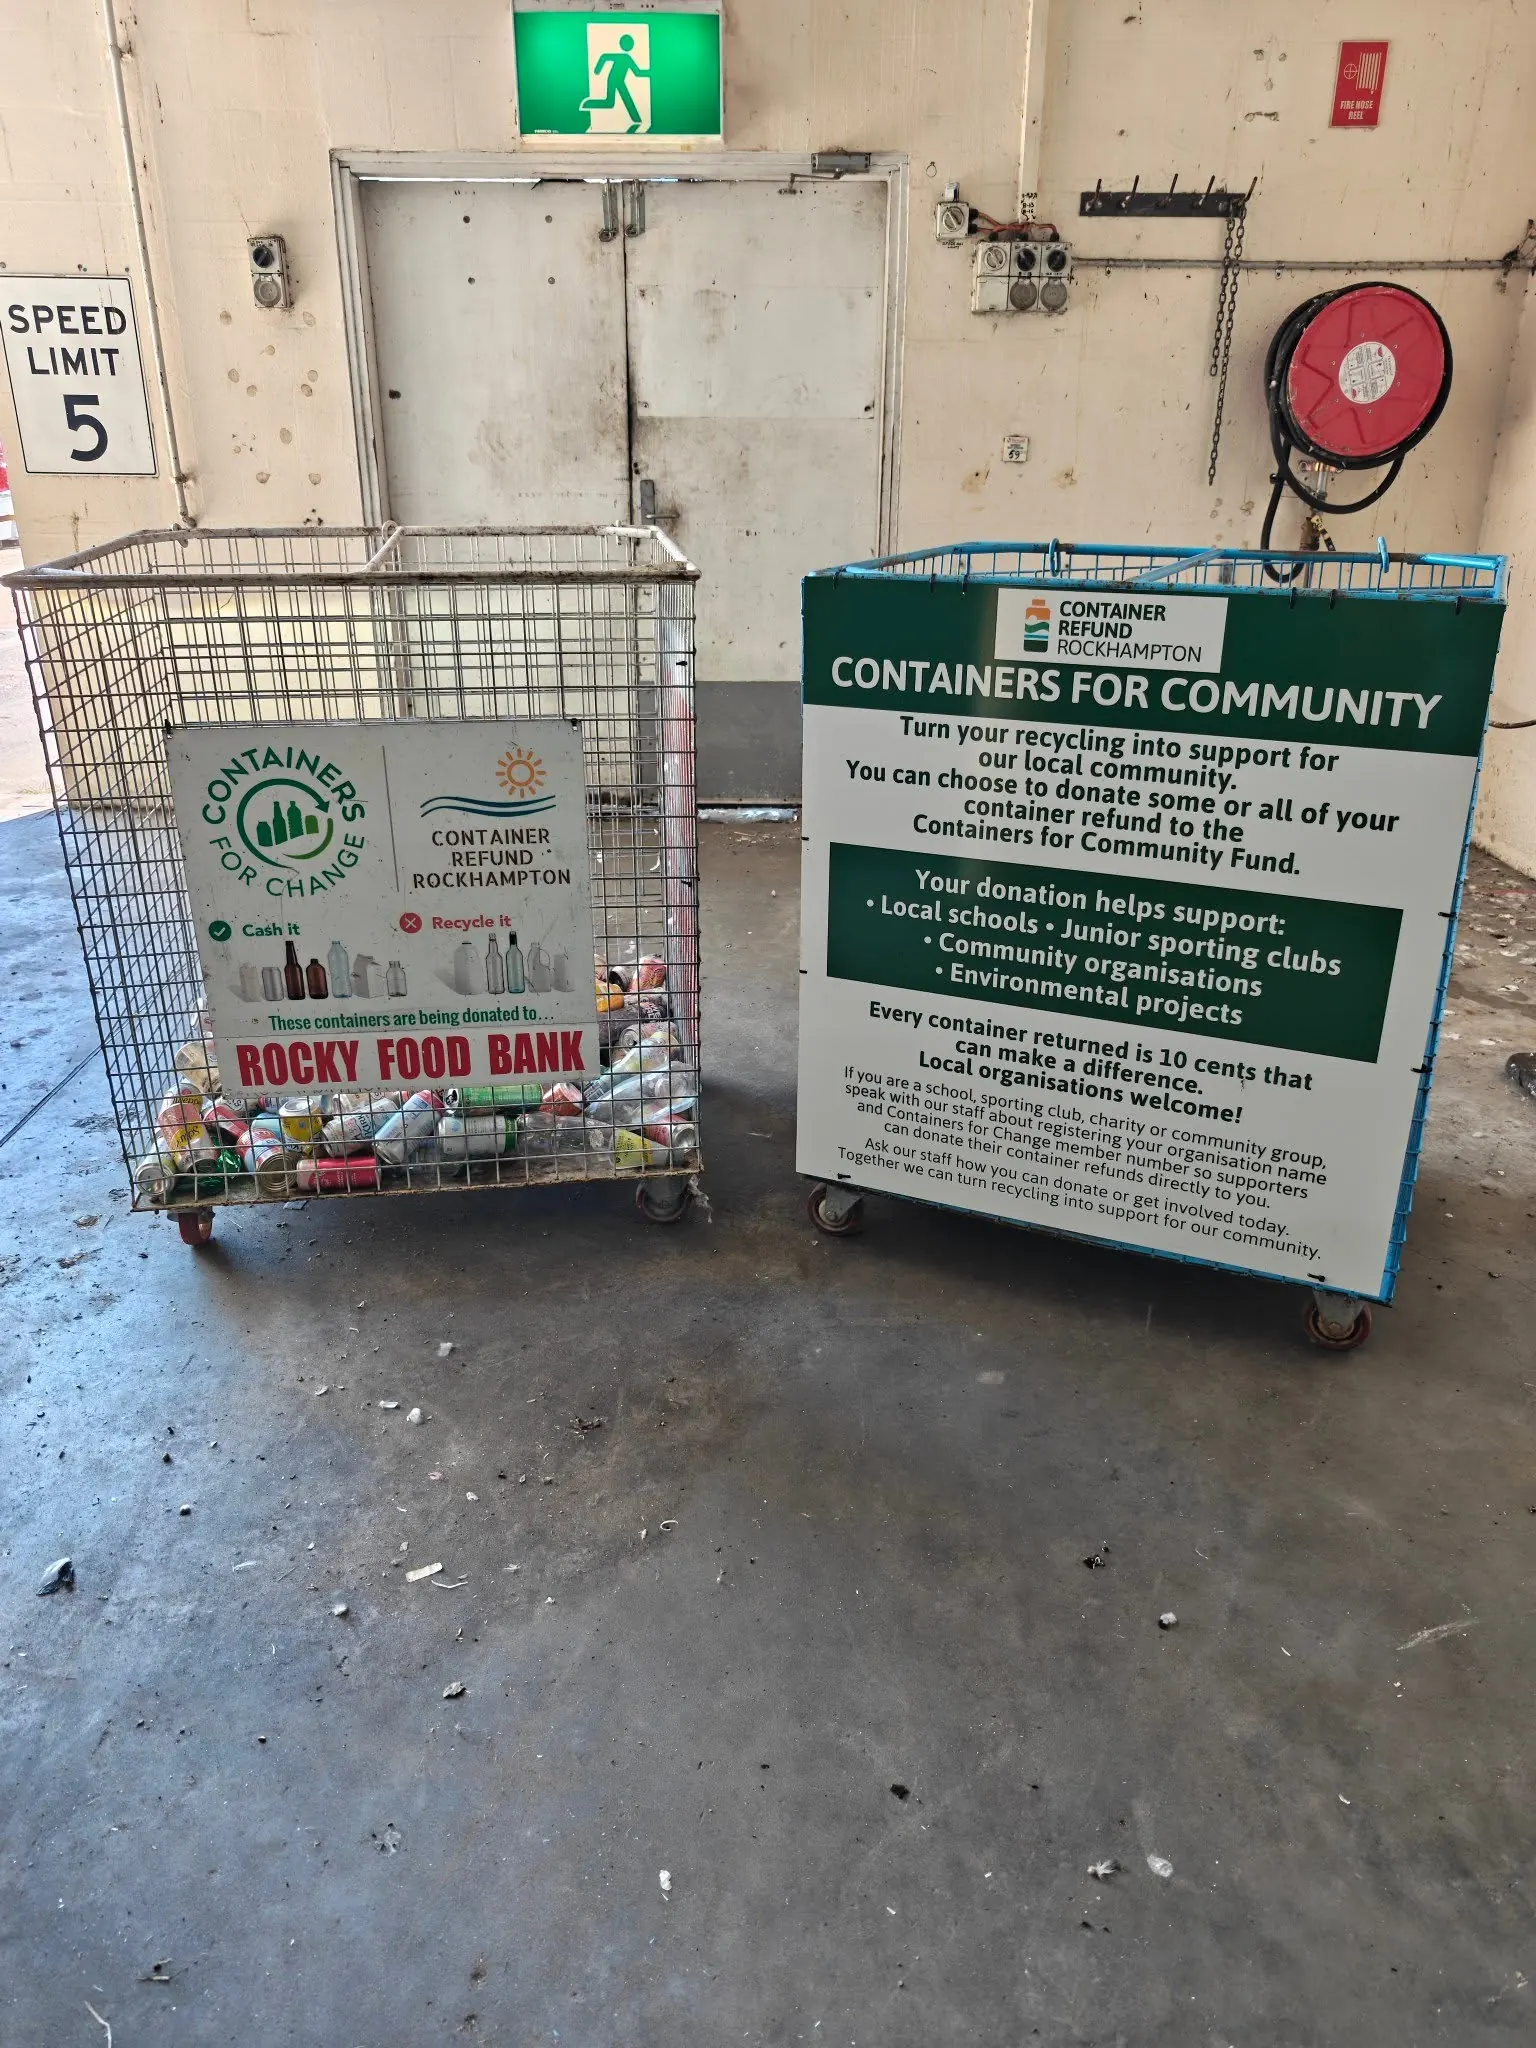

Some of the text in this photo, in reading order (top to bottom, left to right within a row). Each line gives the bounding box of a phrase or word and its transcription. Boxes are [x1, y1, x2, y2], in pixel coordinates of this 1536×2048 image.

[1340, 100, 1373, 110] FIRE HOSE
[1348, 110, 1363, 120] REEL
[8, 304, 126, 335] SPEED
[27, 346, 119, 376] LIMIT
[63, 394, 108, 462] 5
[1058, 619, 1132, 639] REFUND
[1059, 600, 1166, 621] CONTAINER
[1057, 638, 1201, 662] ROCKHAMPTON
[831, 656, 1442, 729] CONTAINERS FOR COMMUNITY
[899, 715, 1339, 771] Turn your recycling into support for
[978, 749, 1236, 794] our local community.
[202, 746, 367, 826] CONTAINERS
[845, 759, 1399, 832] You can choose to donate some or all of your
[431, 828, 550, 847] CONTAINER
[913, 813, 1299, 874] Containers for Community Fund.
[964, 799, 1243, 842] container refund to the
[209, 833, 366, 898] FOR CHANGE
[413, 869, 571, 889] ROCKHAMPTON
[452, 850, 534, 867] REFUND
[242, 922, 300, 938] Cash it
[432, 914, 511, 933] Recycle it
[915, 869, 1285, 935] Your donation helps support:
[881, 894, 1341, 975] Local schools Junior sporting clubs
[939, 932, 1262, 996] Community organisations
[269, 1013, 311, 1031] These
[314, 1011, 391, 1029] containers
[394, 1012, 416, 1027] are
[419, 1007, 459, 1026] being
[462, 1004, 519, 1023] donated
[950, 962, 1242, 1024] Environmental projects
[236, 1030, 586, 1087] ROCKY FOOD BANK
[869, 1000, 1312, 1090] Every container returned is 10 cents that
[955, 1040, 1202, 1094] can make a difference.
[919, 1050, 1242, 1123] Local organisations welcome!
[844, 1065, 1325, 1169] If you are a school, sporting club, charity or community group,
[845, 1084, 1326, 1185] speak with our staff about registering your organisation name
[857, 1102, 1307, 1198] and Containers for Change member number so supporters
[884, 1122, 1269, 1208] can donate their container refunds directly to you.
[837, 1146, 1320, 1260] Together we can turn recycling into support for our community.
[864, 1137, 1288, 1237] Ask our staff how you can donate or get involved today.
